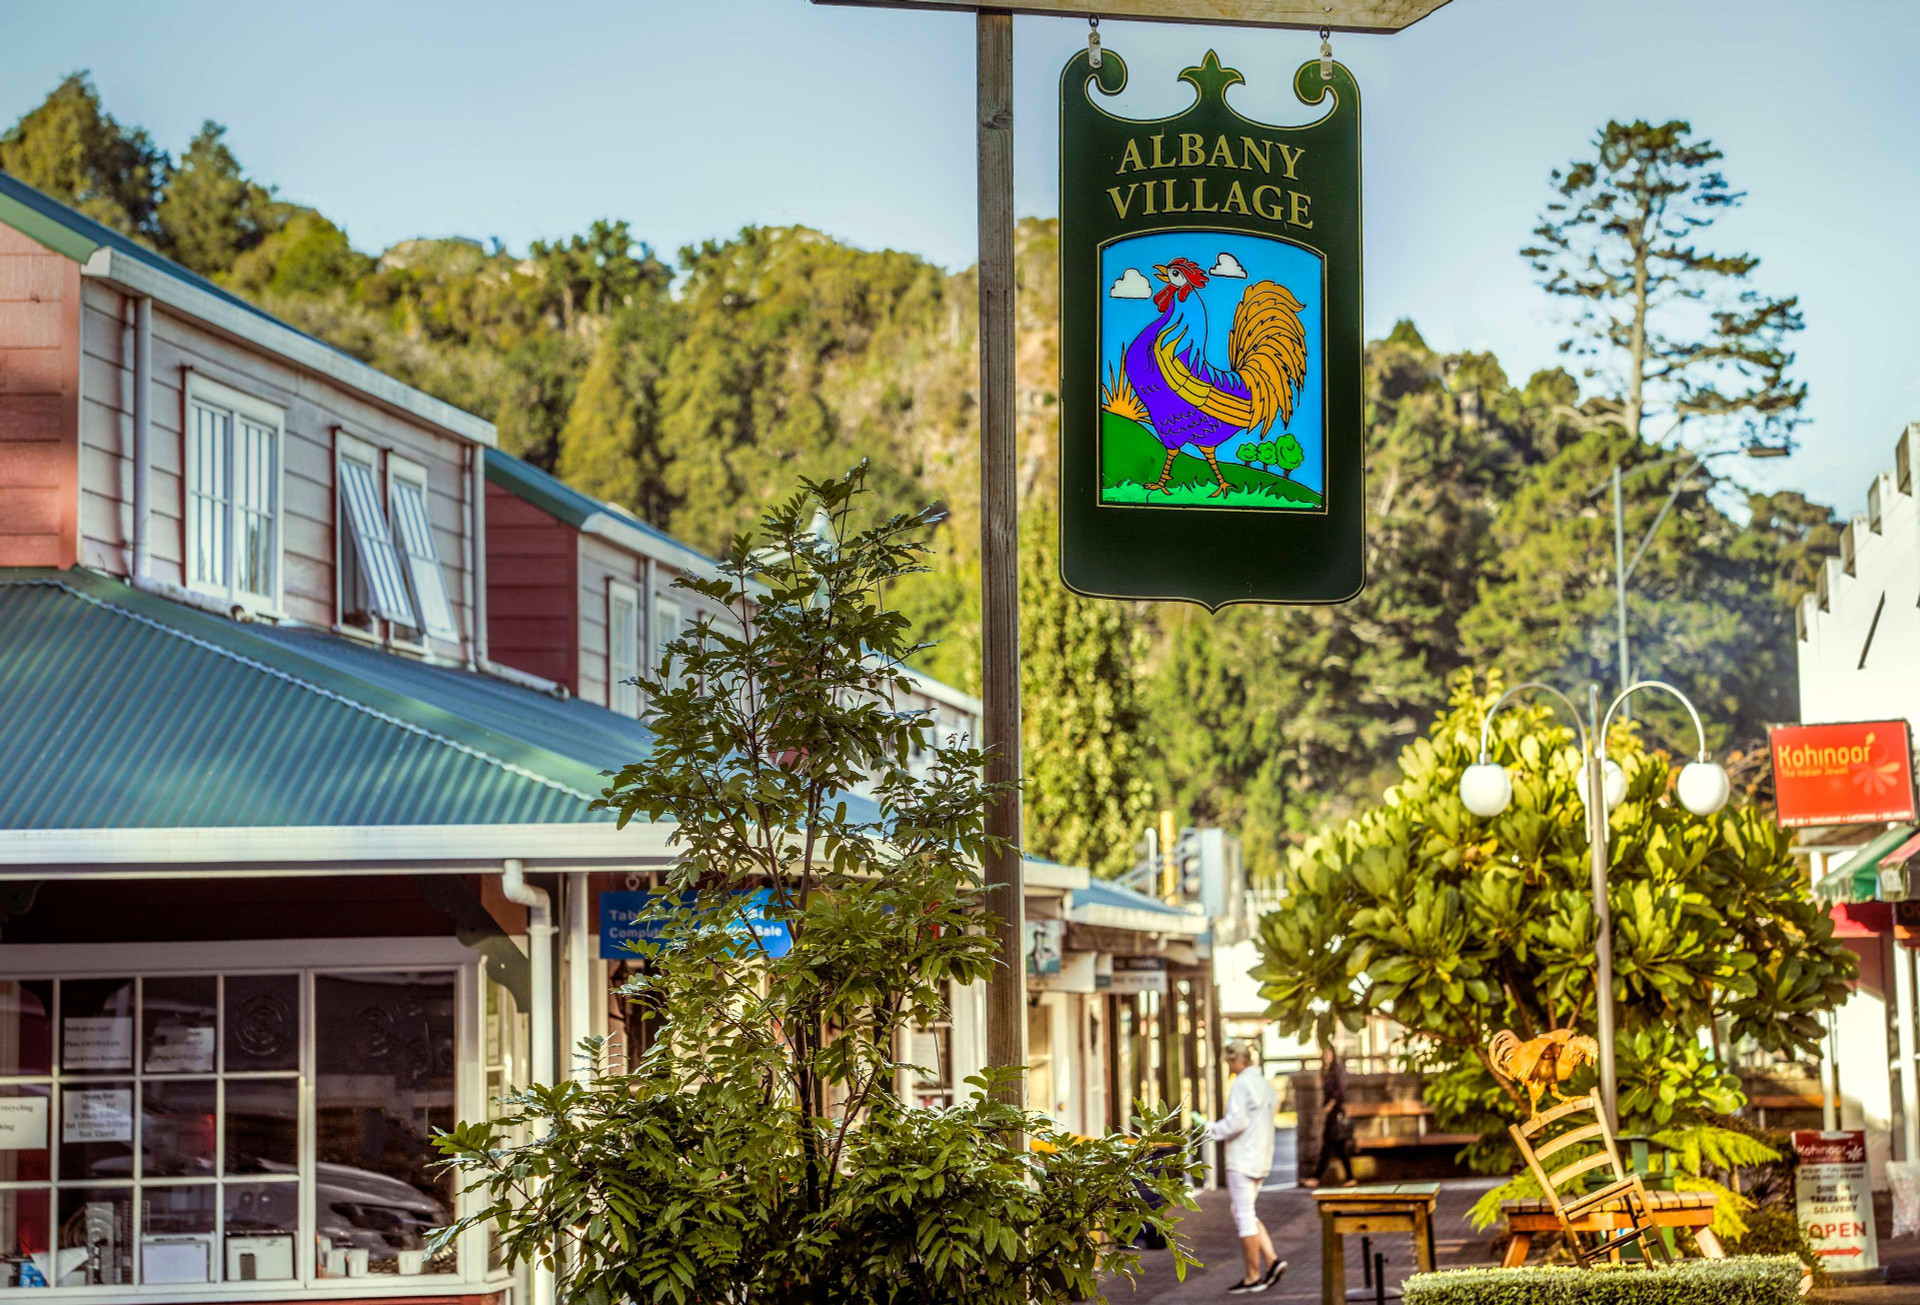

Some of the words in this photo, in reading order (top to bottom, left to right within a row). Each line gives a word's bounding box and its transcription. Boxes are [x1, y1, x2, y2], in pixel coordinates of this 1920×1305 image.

[1116, 133, 1306, 181] ALBANY
[1106, 178, 1314, 230] VILLAGE
[1777, 743, 1871, 769] Kohinoor
[1808, 1221, 1868, 1239] OPEN
